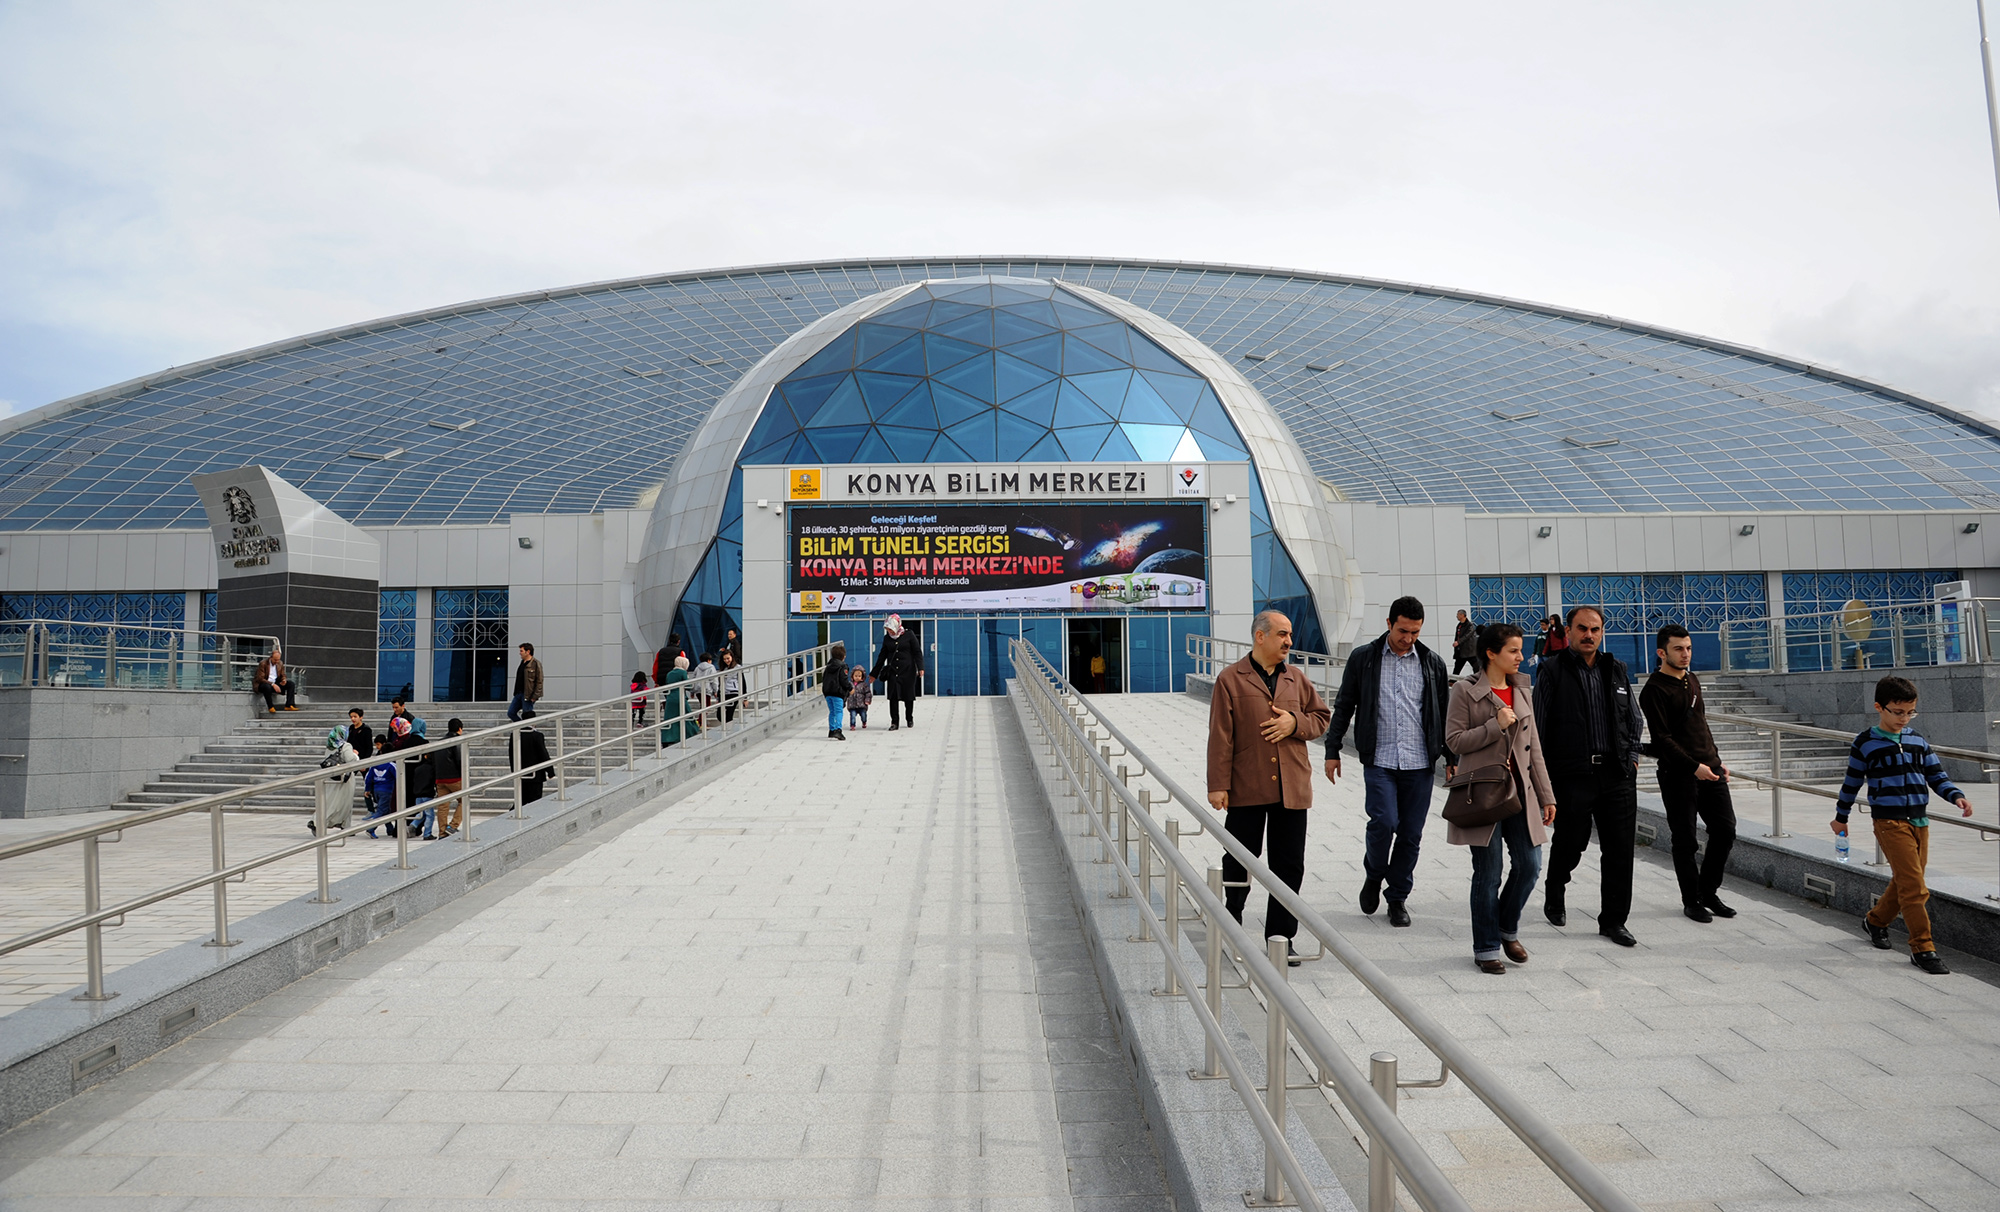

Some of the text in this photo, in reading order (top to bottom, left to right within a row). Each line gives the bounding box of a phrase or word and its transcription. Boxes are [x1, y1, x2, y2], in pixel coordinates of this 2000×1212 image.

[848, 473, 937, 494] KONYA
[870, 515, 938, 526] Geleceği Keşfet!
[801, 524, 1007, 536] 18 ülkede, 30 şehirde, 10 milyon ziyaretçinin gezdiği sergi
[800, 558, 868, 577] KONYA
[840, 578, 849, 586] 13
[850, 578, 868, 586] Mart
[873, 577, 883, 586] 31
[883, 577, 906, 587] Mayıs
[907, 576, 936, 586] tarihleri
[936, 576, 970, 585] arasında
